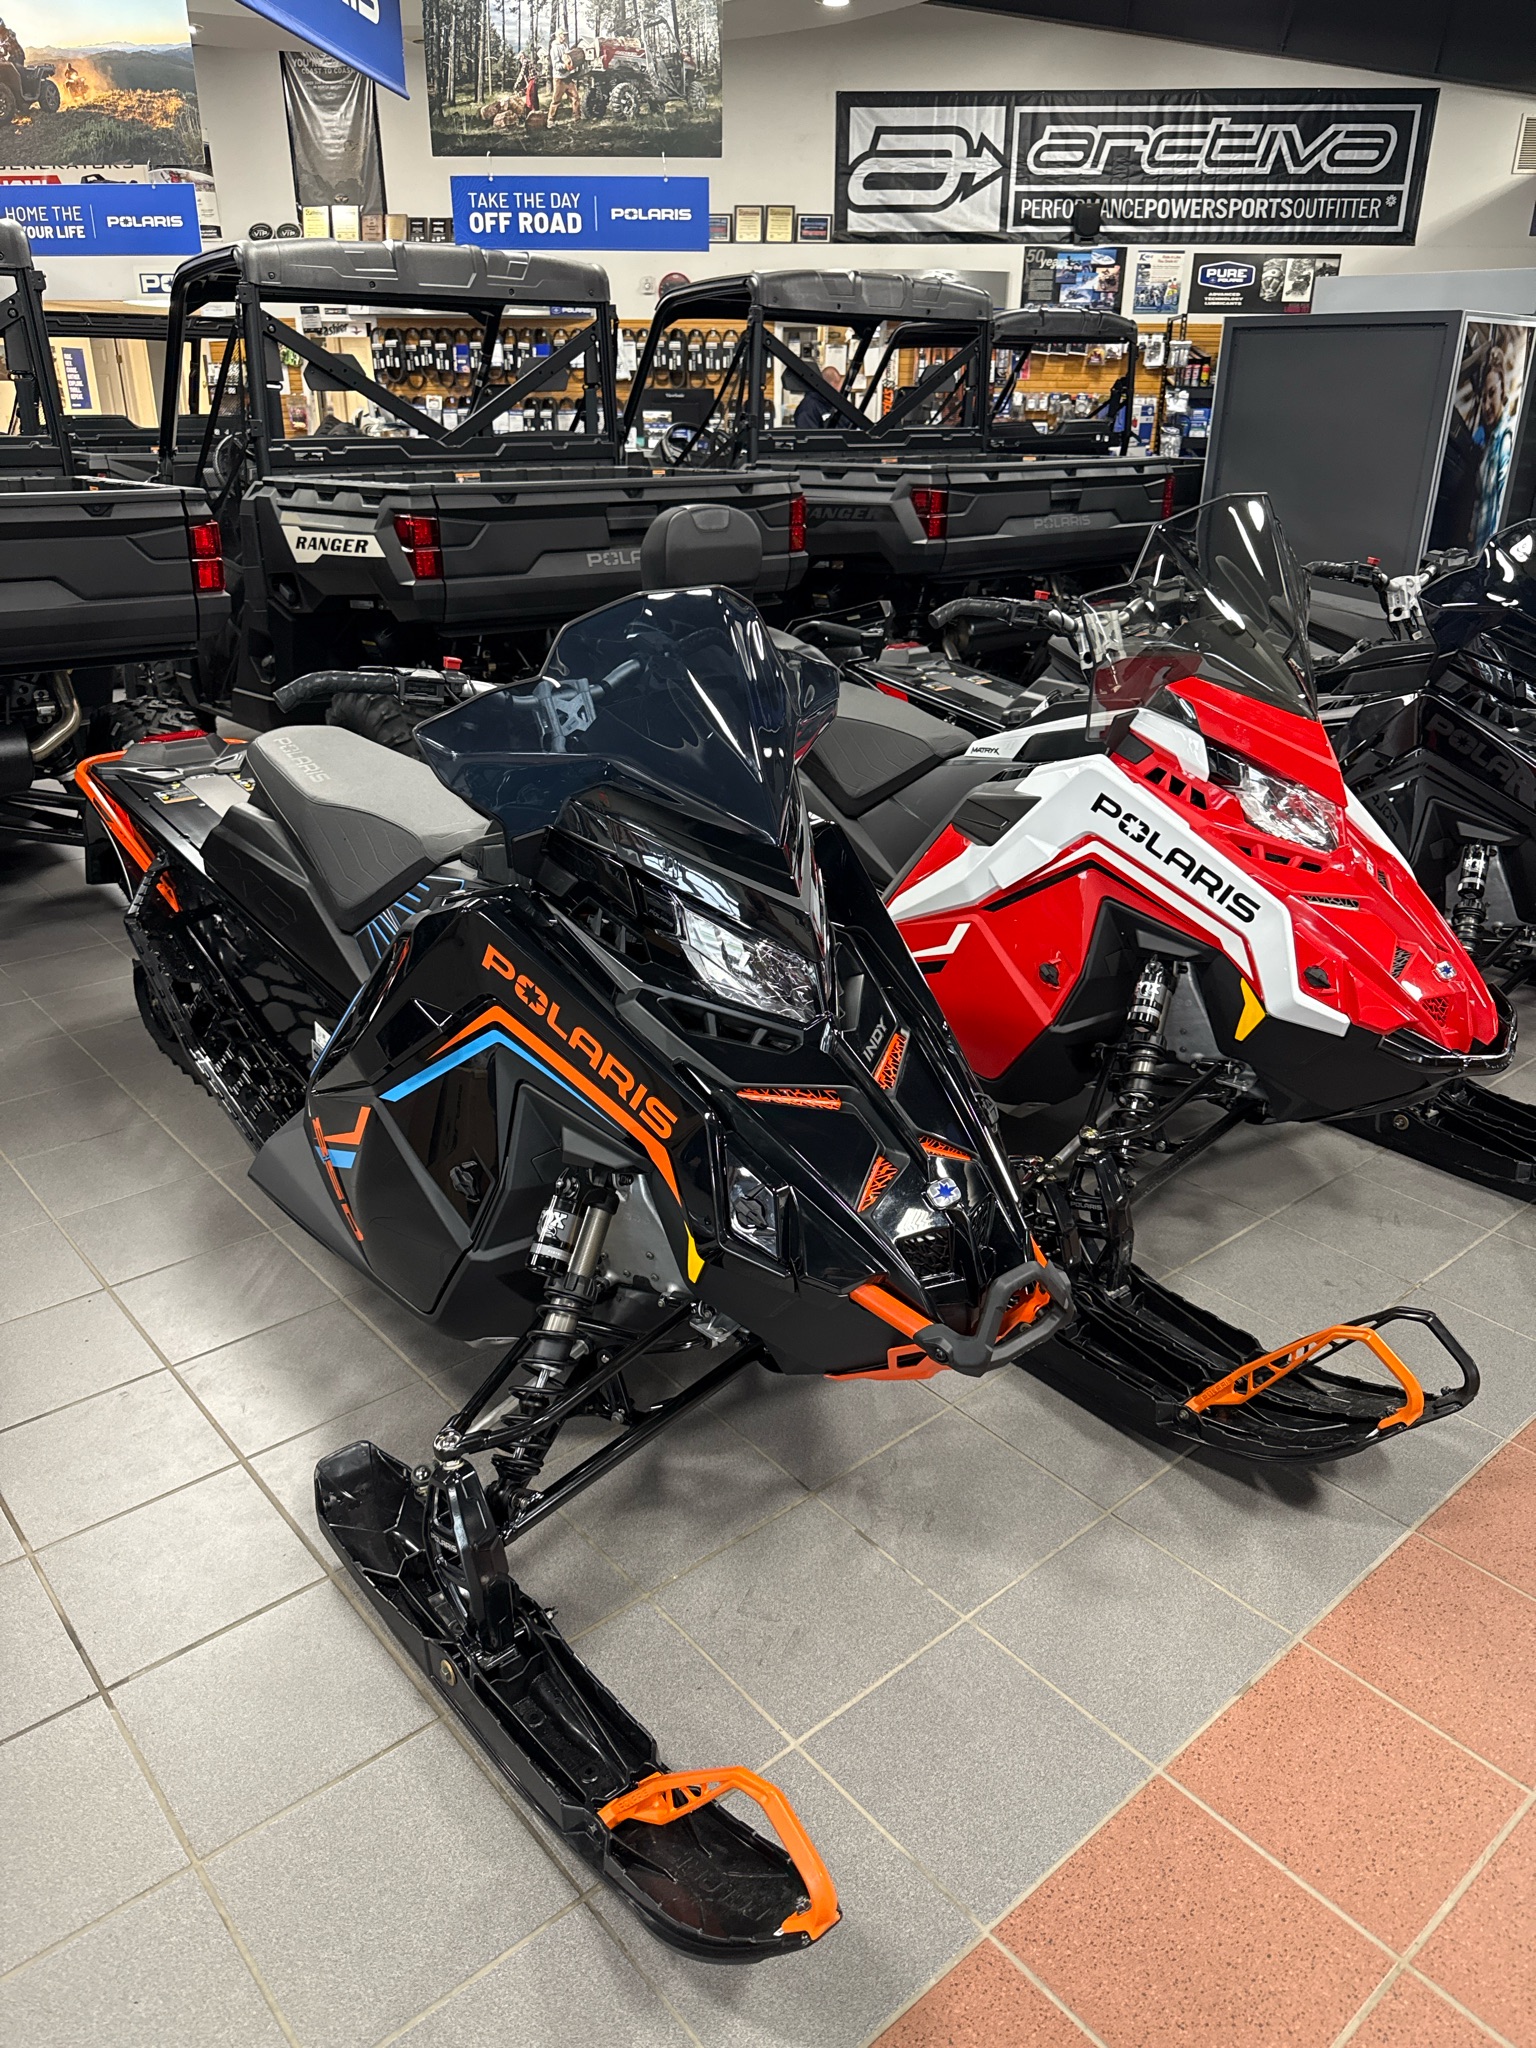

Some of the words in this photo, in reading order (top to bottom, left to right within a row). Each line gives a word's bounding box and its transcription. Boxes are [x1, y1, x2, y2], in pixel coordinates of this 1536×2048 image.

[1027, 117, 1398, 176] arctiva
[5, 206, 48, 222] HOME
[51, 206, 83, 221] THE
[106, 215, 184, 228] POLARIS
[468, 193, 508, 208] TAKE
[513, 193, 544, 208] THE
[550, 193, 580, 208] DAY
[610, 208, 692, 221] POLARIS
[1020, 197, 1380, 221] PERFOANCEPOWERSPORTSOUTFITTER
[57, 225, 86, 239] LIFE
[469, 212, 512, 233] OFF
[518, 212, 582, 234] ROAD
[1025, 248, 1046, 263] 50
[1206, 268, 1248, 279] PURE
[321, 322, 349, 337] ashier
[806, 507, 880, 520] ANGER
[1033, 515, 1091, 530] POLARIS
[295, 536, 369, 554] RANGER
[273, 737, 331, 783] POLARIS
[970, 746, 1000, 756] MATRYX
[1090, 792, 1262, 924] POLARIS
[481, 943, 679, 1140] POLARIS
[862, 1014, 888, 1062] INDY
